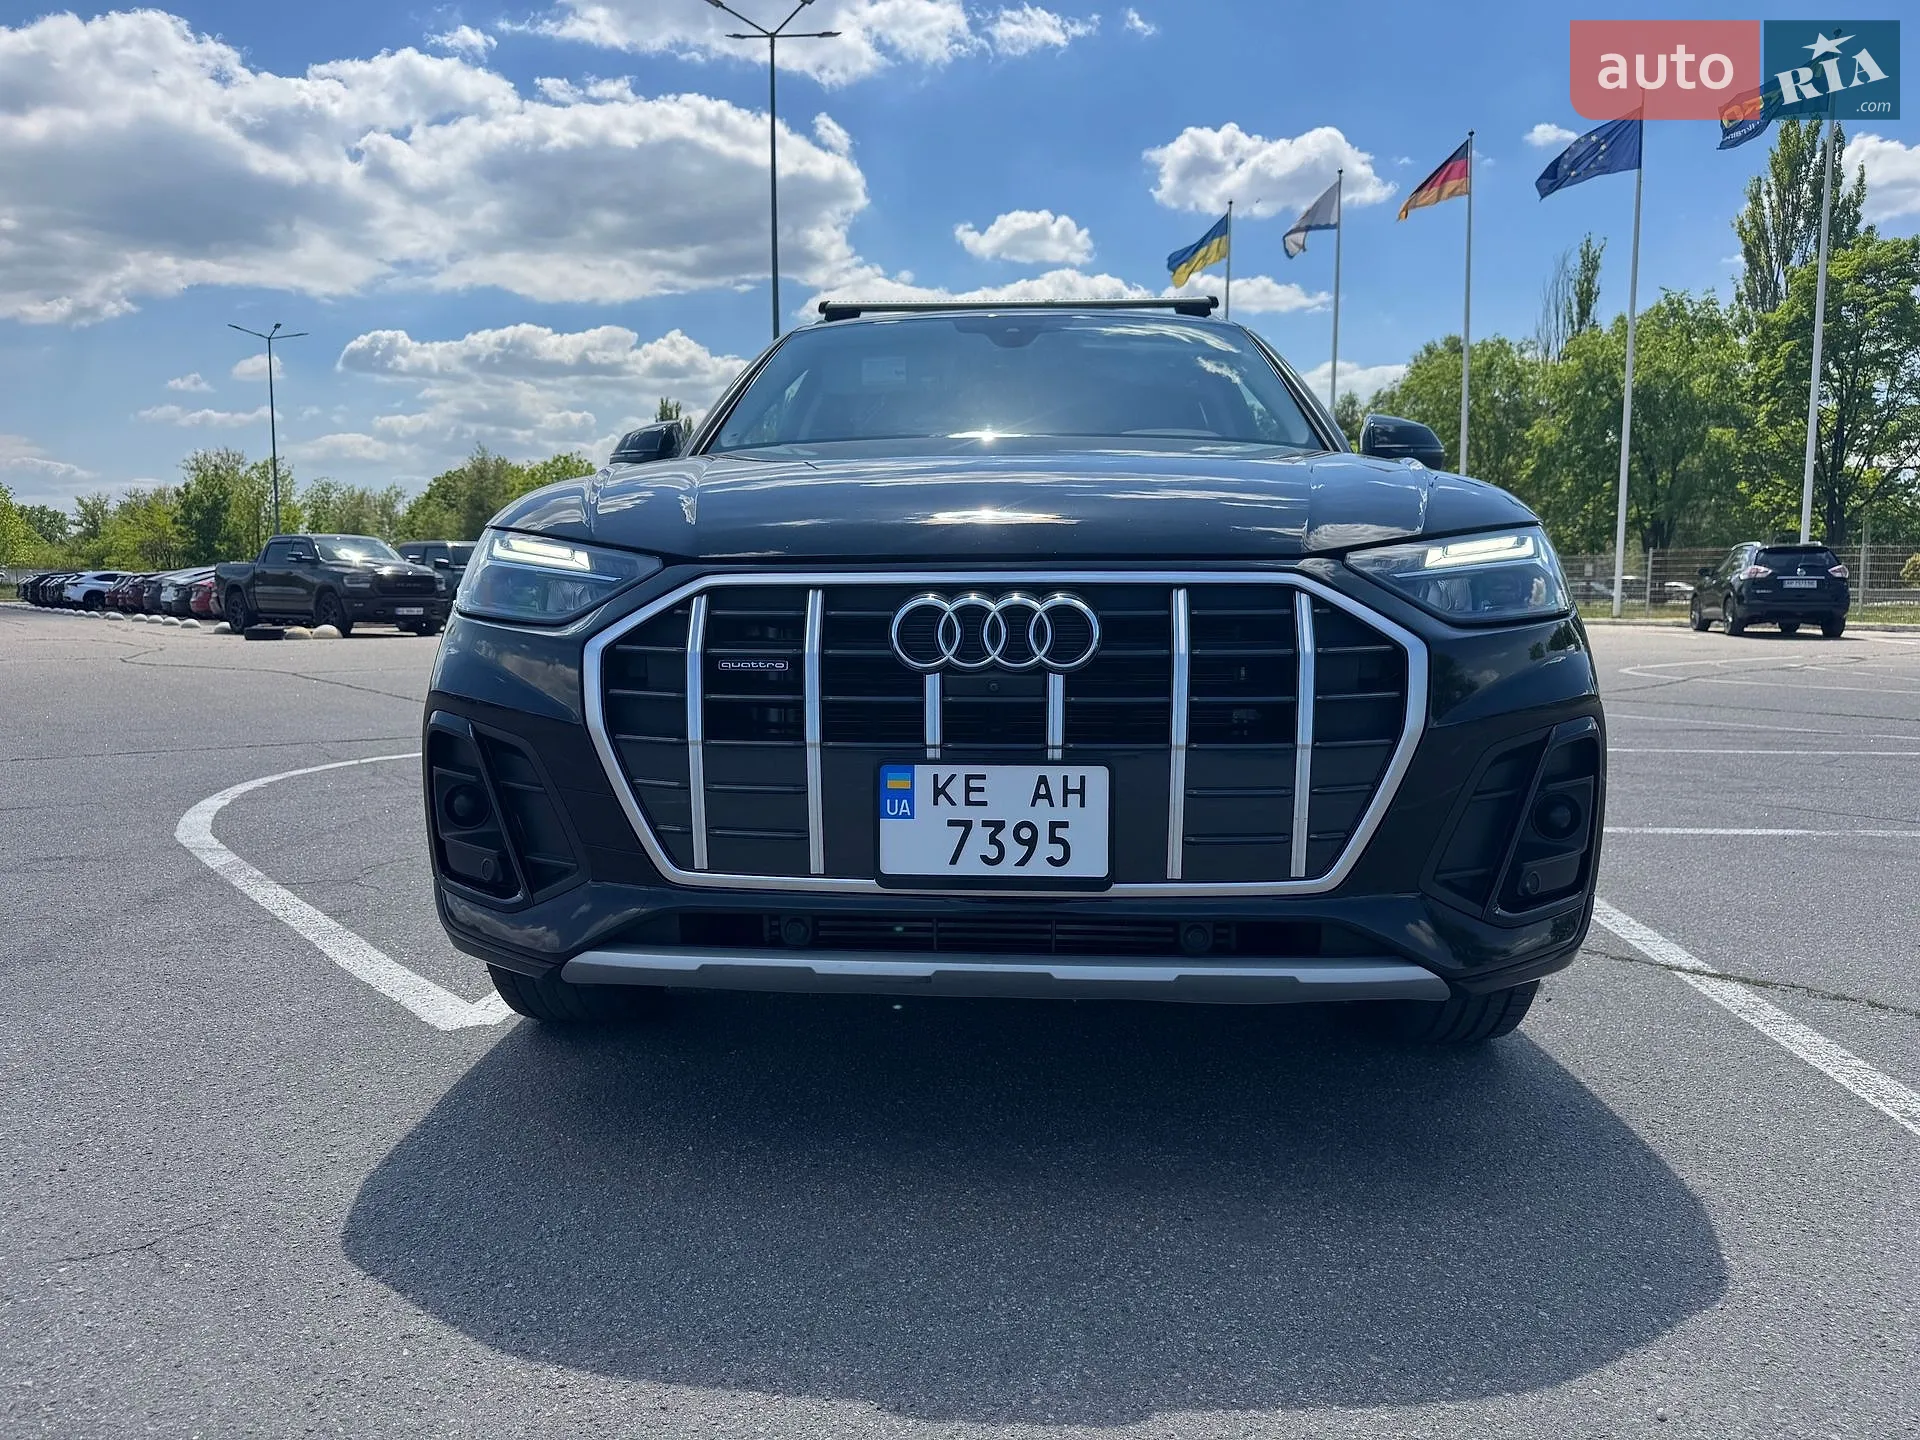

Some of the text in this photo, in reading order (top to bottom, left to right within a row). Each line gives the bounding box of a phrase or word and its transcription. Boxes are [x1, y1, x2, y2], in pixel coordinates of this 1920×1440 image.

[721, 661, 785, 669] quattro
[932, 773, 1086, 808] KE AH
[886, 799, 911, 816] UA
[946, 819, 1071, 867] 7395
